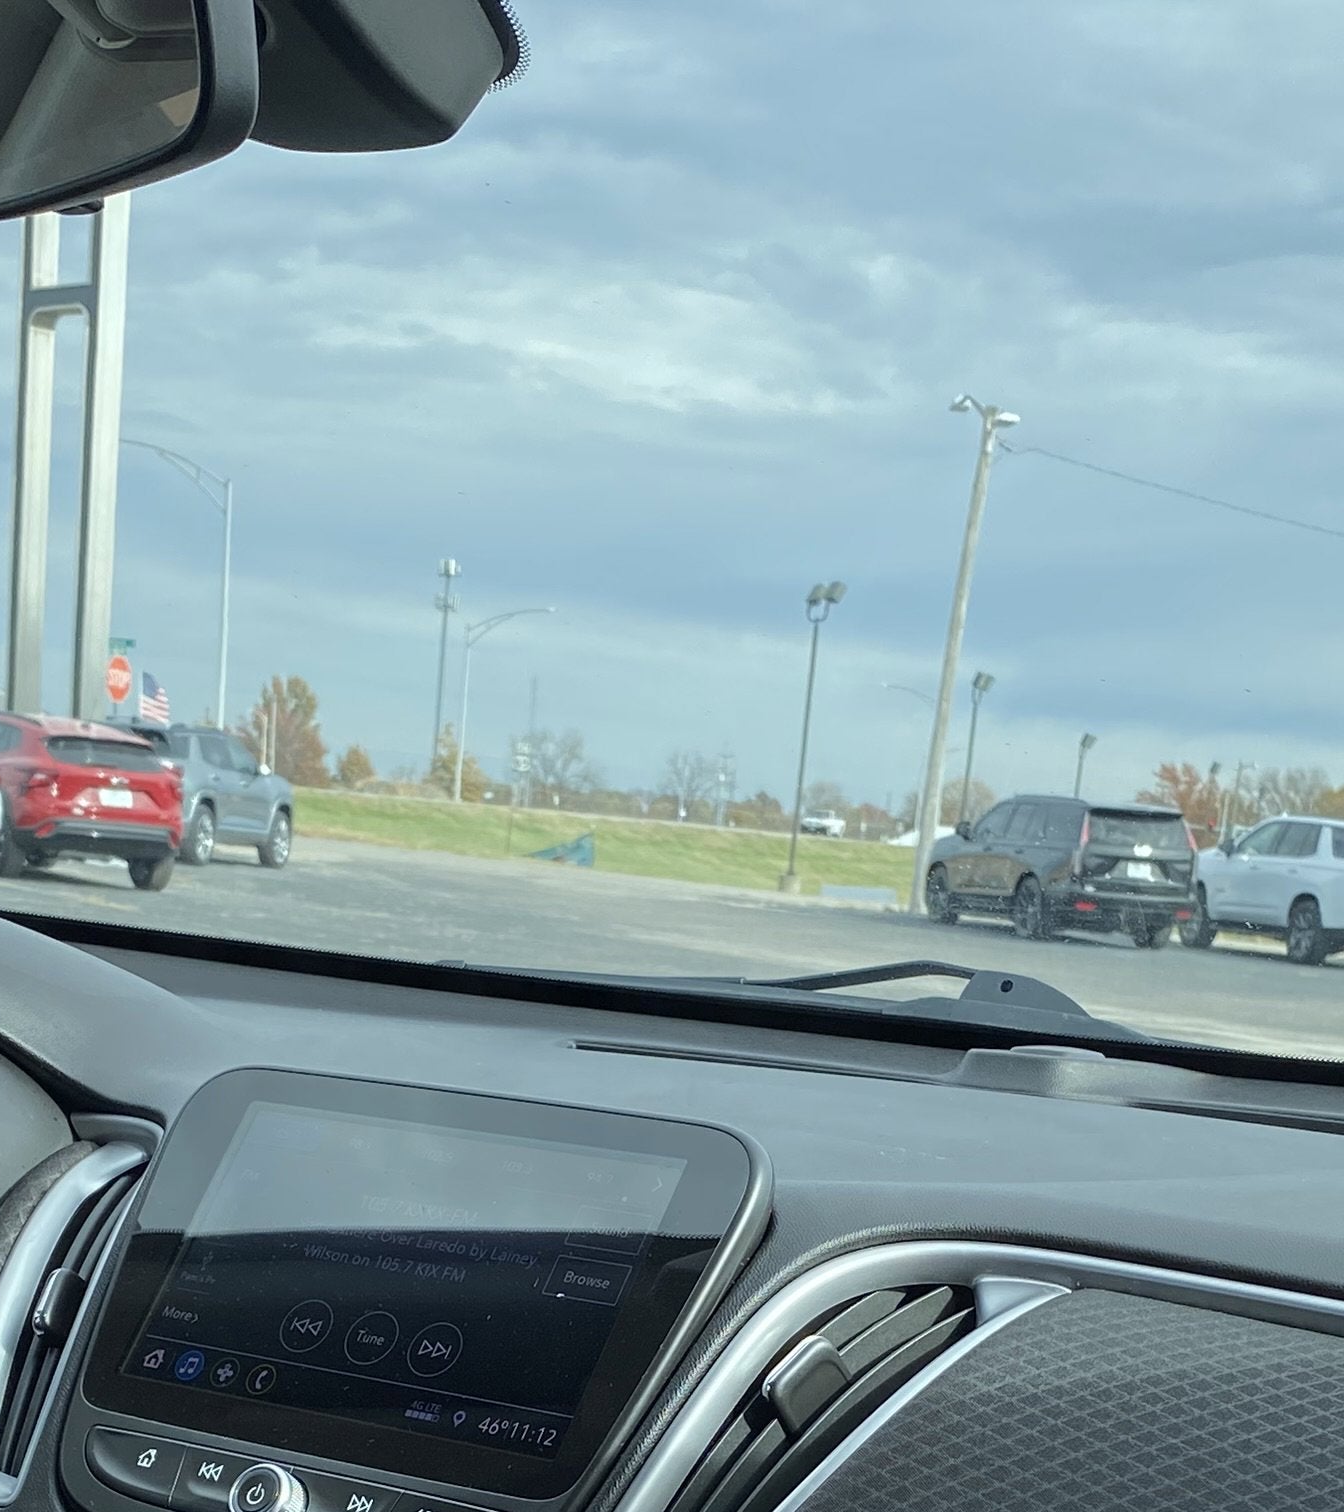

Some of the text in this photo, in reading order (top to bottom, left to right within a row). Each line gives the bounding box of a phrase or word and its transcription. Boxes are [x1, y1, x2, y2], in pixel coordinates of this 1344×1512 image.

[108, 668, 130, 688] STOP
[416, 1236, 466, 1255] Laredo
[468, 1241, 488, 1261] by
[490, 1247, 538, 1270] Lainey
[304, 1244, 349, 1263] Wilson
[352, 1255, 371, 1267] on
[375, 1255, 414, 1276] 105.7
[441, 1266, 466, 1283] FM
[563, 1268, 612, 1290] Browse
[162, 1305, 193, 1321] More
[356, 1328, 385, 1346] Tune
[410, 1400, 443, 1414] 4G LTE
